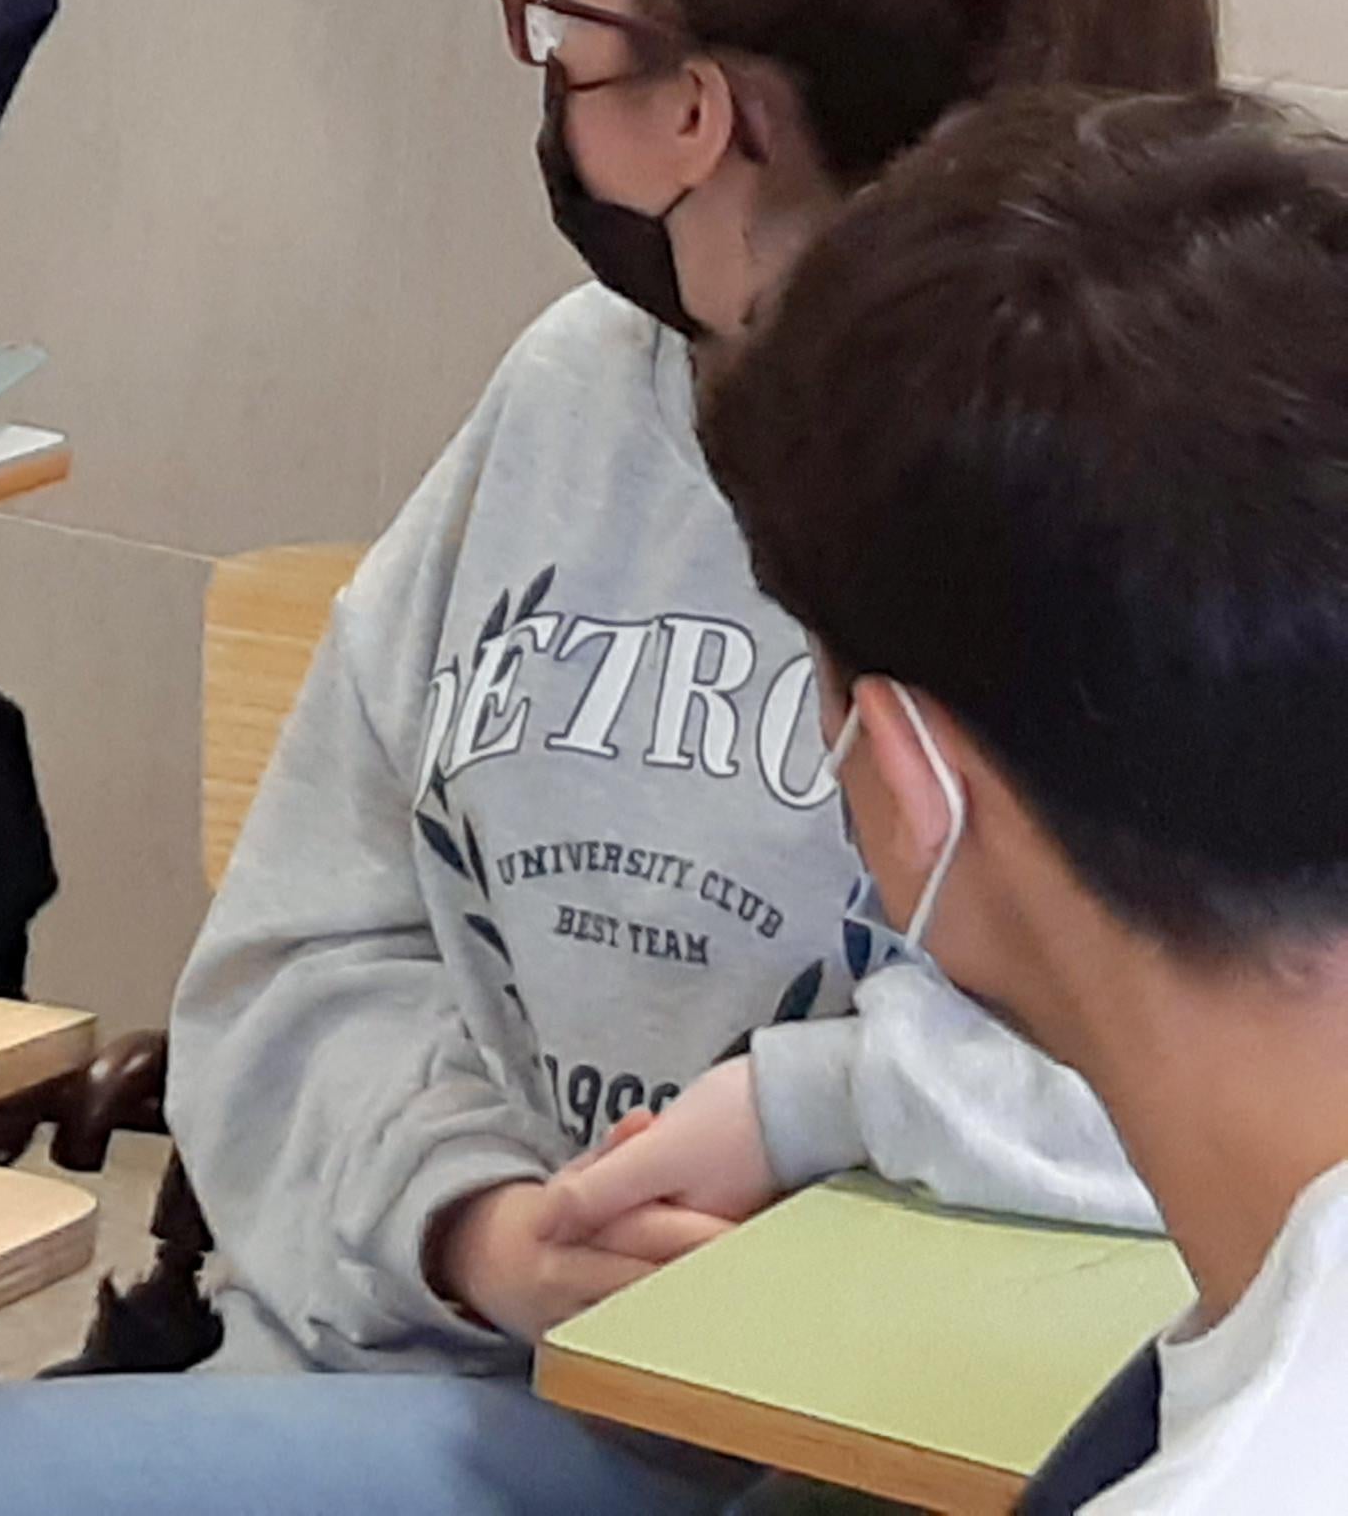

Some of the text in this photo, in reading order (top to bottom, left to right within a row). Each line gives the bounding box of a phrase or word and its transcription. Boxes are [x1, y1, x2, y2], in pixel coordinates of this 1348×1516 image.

[495, 840, 786, 940] UNIVERSITY CLUB
[553, 902, 712, 966] BEST TEAM
